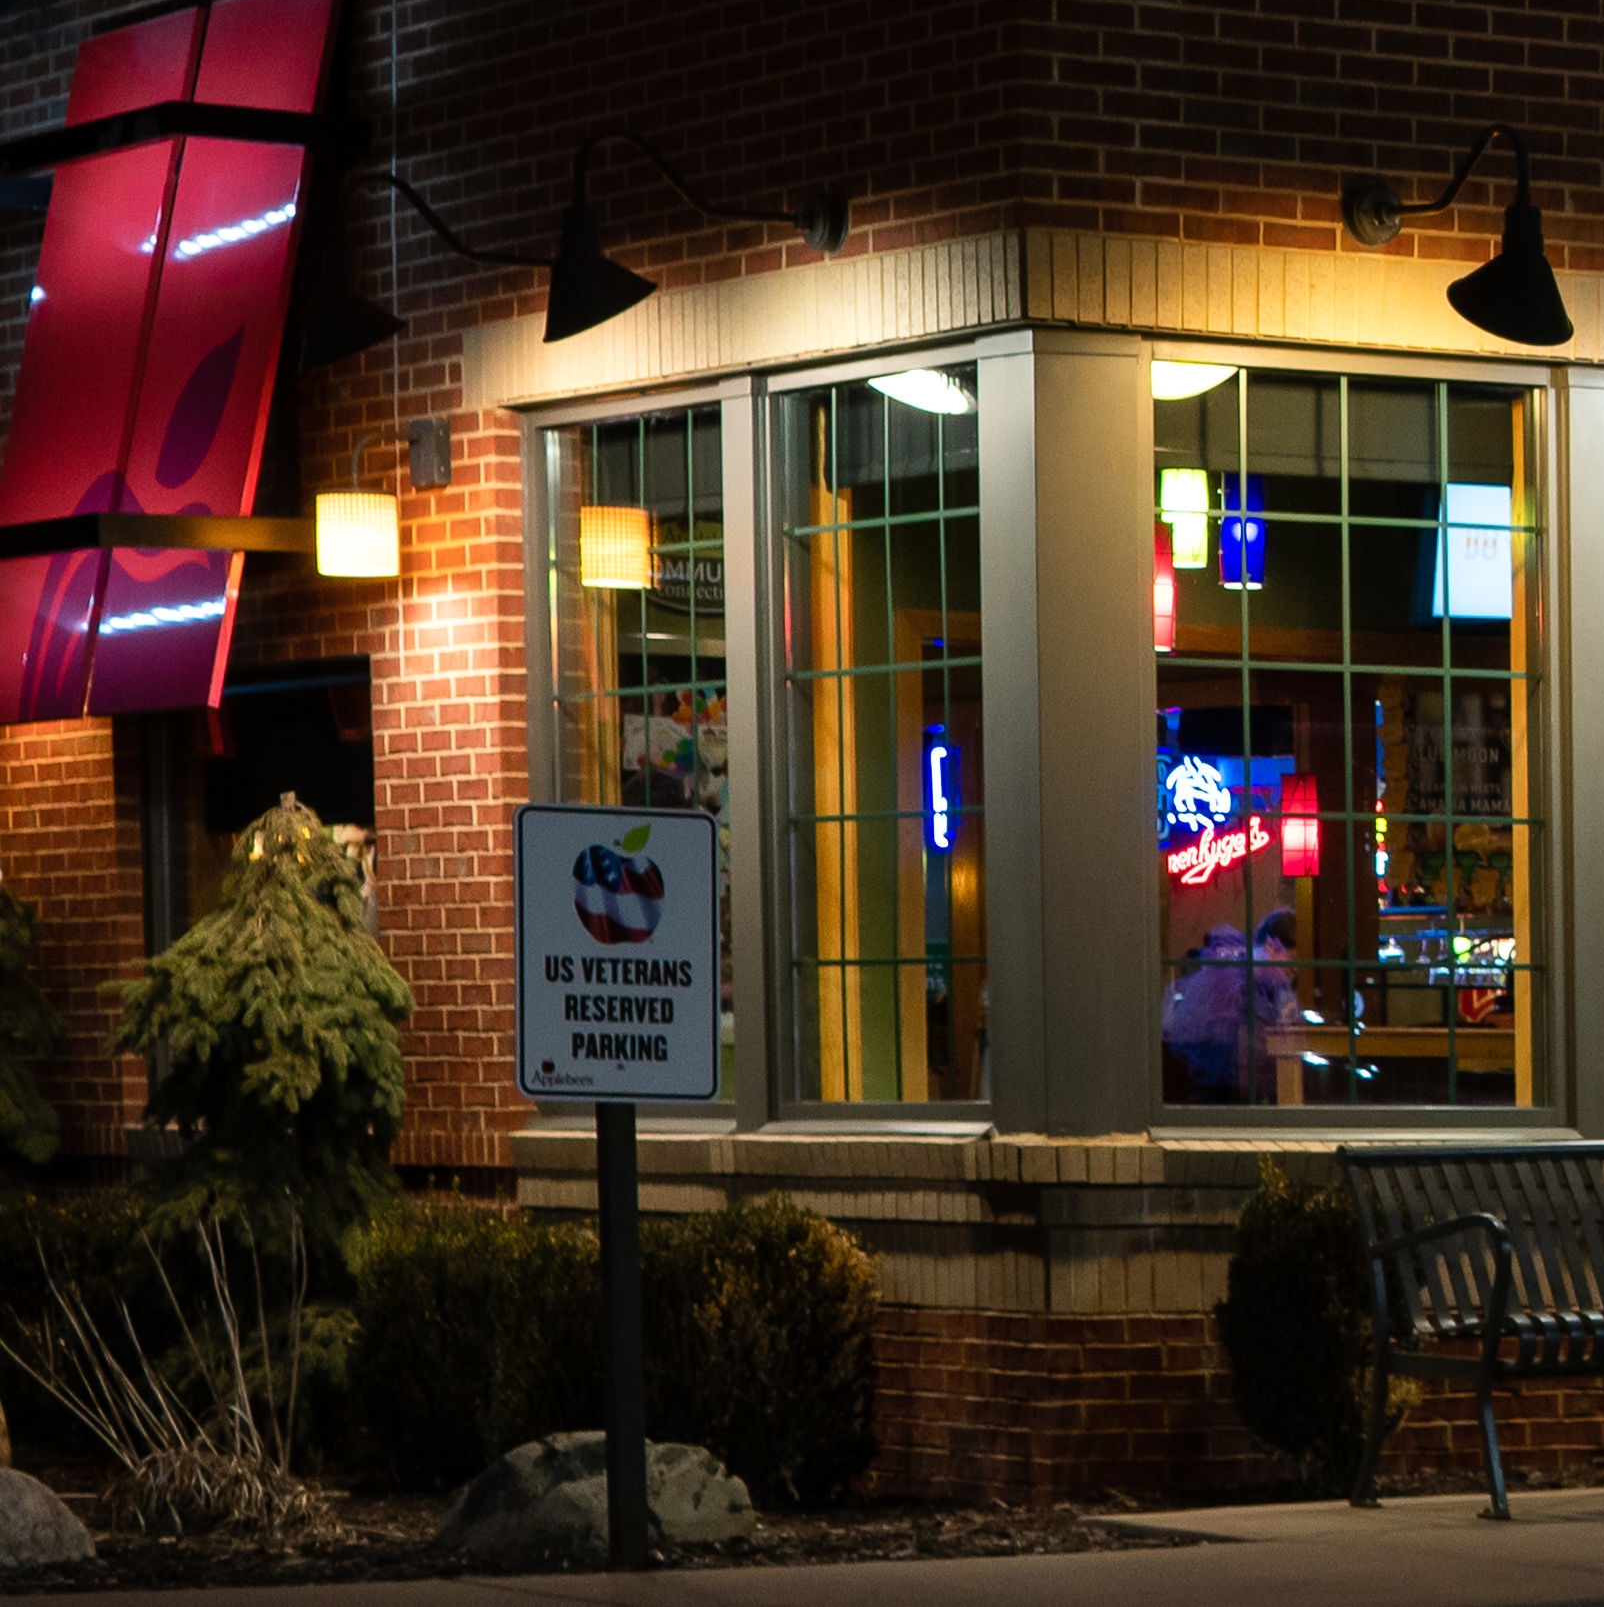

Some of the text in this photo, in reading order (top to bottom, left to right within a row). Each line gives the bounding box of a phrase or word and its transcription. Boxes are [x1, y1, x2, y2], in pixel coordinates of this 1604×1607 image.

[545, 955, 693, 988] US VETERANS
[564, 993, 675, 1025] RESERVED
[571, 1031, 668, 1062] PARKING
